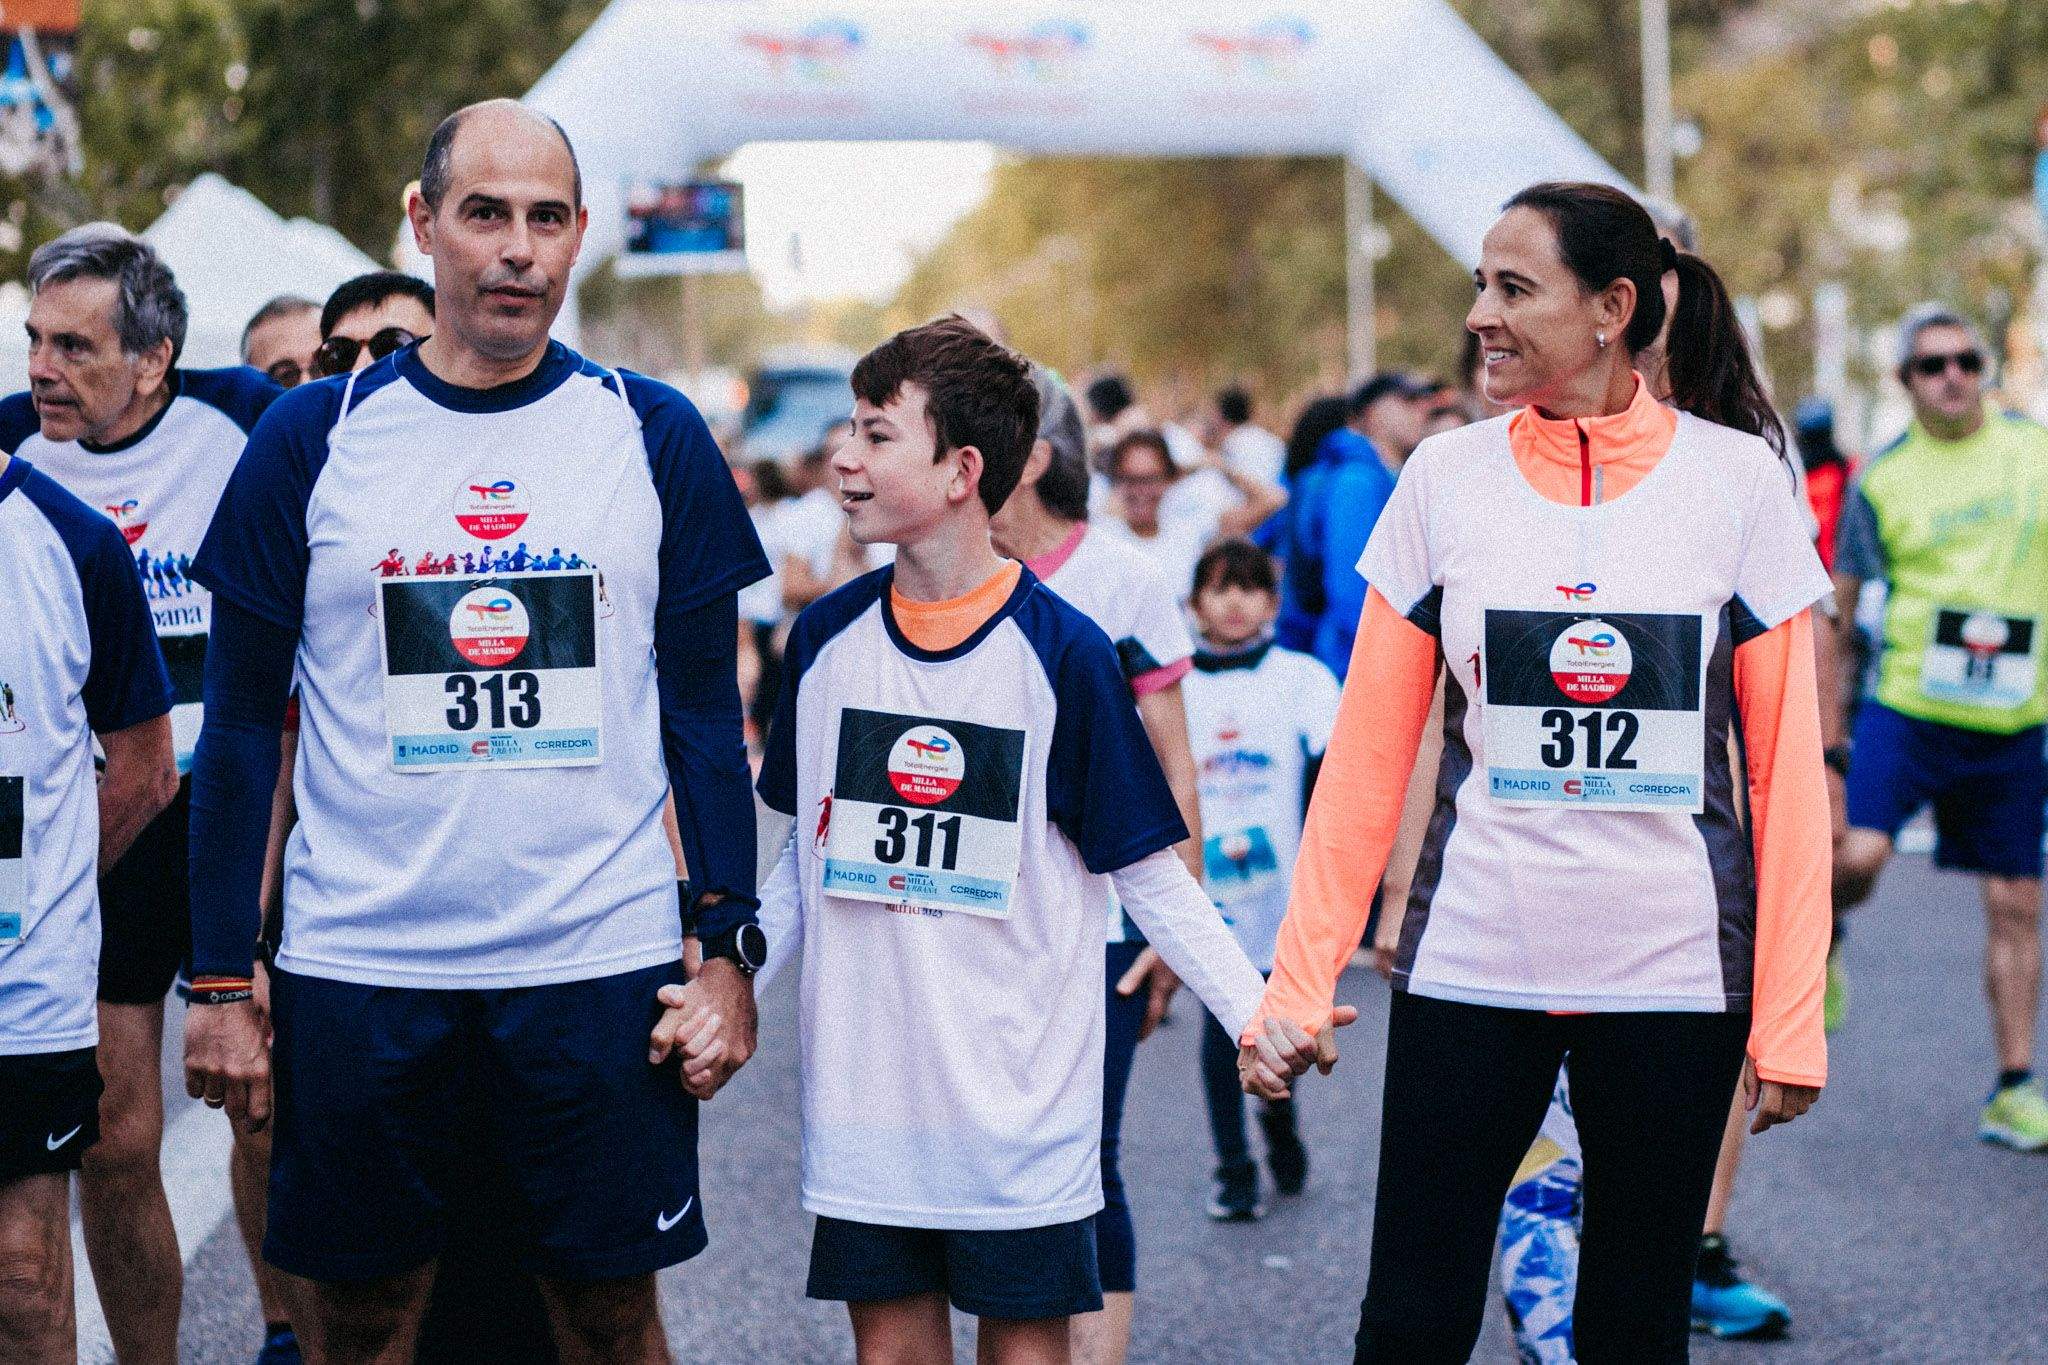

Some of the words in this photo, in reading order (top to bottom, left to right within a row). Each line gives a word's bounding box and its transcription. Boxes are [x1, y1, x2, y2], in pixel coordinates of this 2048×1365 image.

[480, 516, 506, 524] MILLA
[482, 523, 516, 531] MADRID
[478, 639, 505, 648] MILLA
[468, 648, 480, 656] DE
[482, 647, 516, 656] MADRID
[1567, 660, 1615, 668] TotalEnergies
[1577, 675, 1605, 683] MILLA
[1582, 684, 1616, 692] MADRID
[445, 672, 541, 731] 313
[1541, 709, 1639, 769] 312
[411, 744, 459, 755] MADRID
[912, 776, 937, 786] MILLA
[1504, 779, 1550, 791] MADRID
[901, 783, 912, 791] DE
[914, 786, 947, 795] MADRID
[875, 807, 961, 870] 311
[833, 870, 876, 884] MADRID
